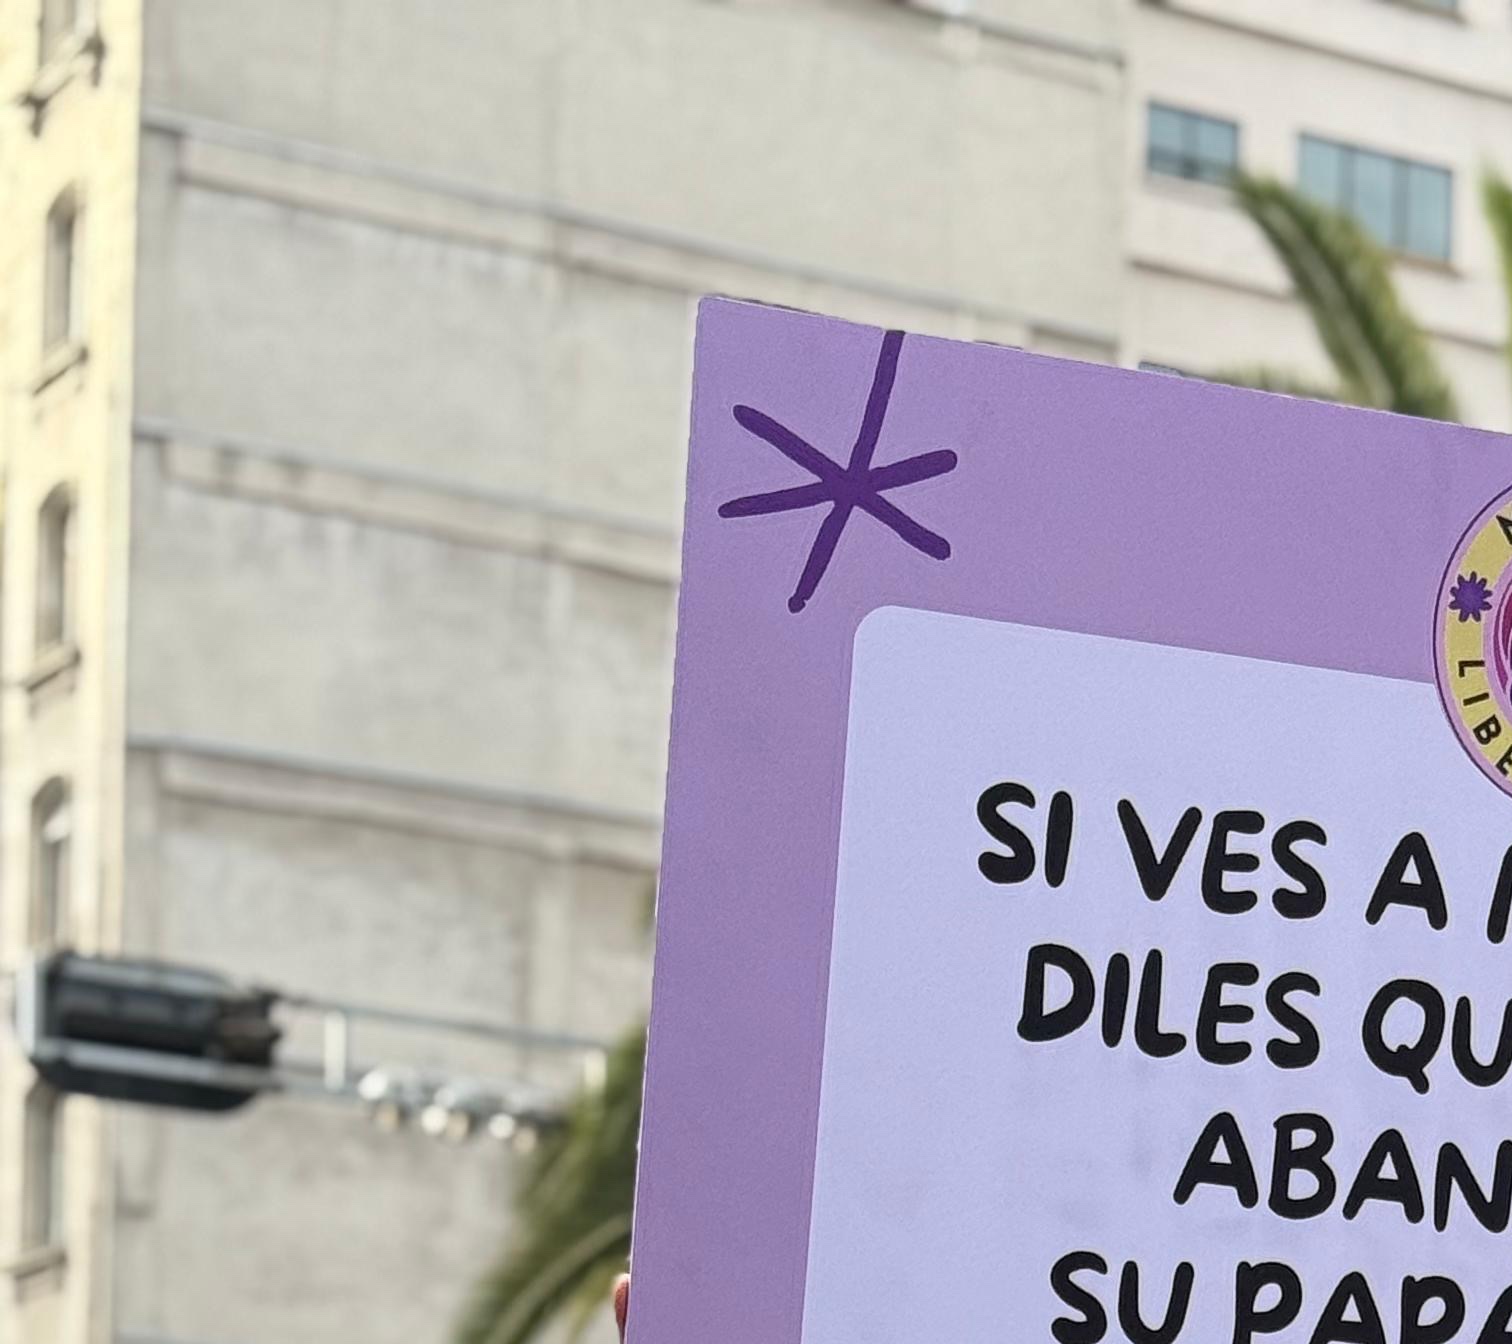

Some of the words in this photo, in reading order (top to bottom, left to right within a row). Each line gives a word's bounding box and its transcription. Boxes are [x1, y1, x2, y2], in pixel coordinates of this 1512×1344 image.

[976, 782, 1074, 888] SI
[1117, 799, 1327, 920] VES
[1365, 832, 1448, 930] A
[1016, 943, 1320, 1069] DILES
